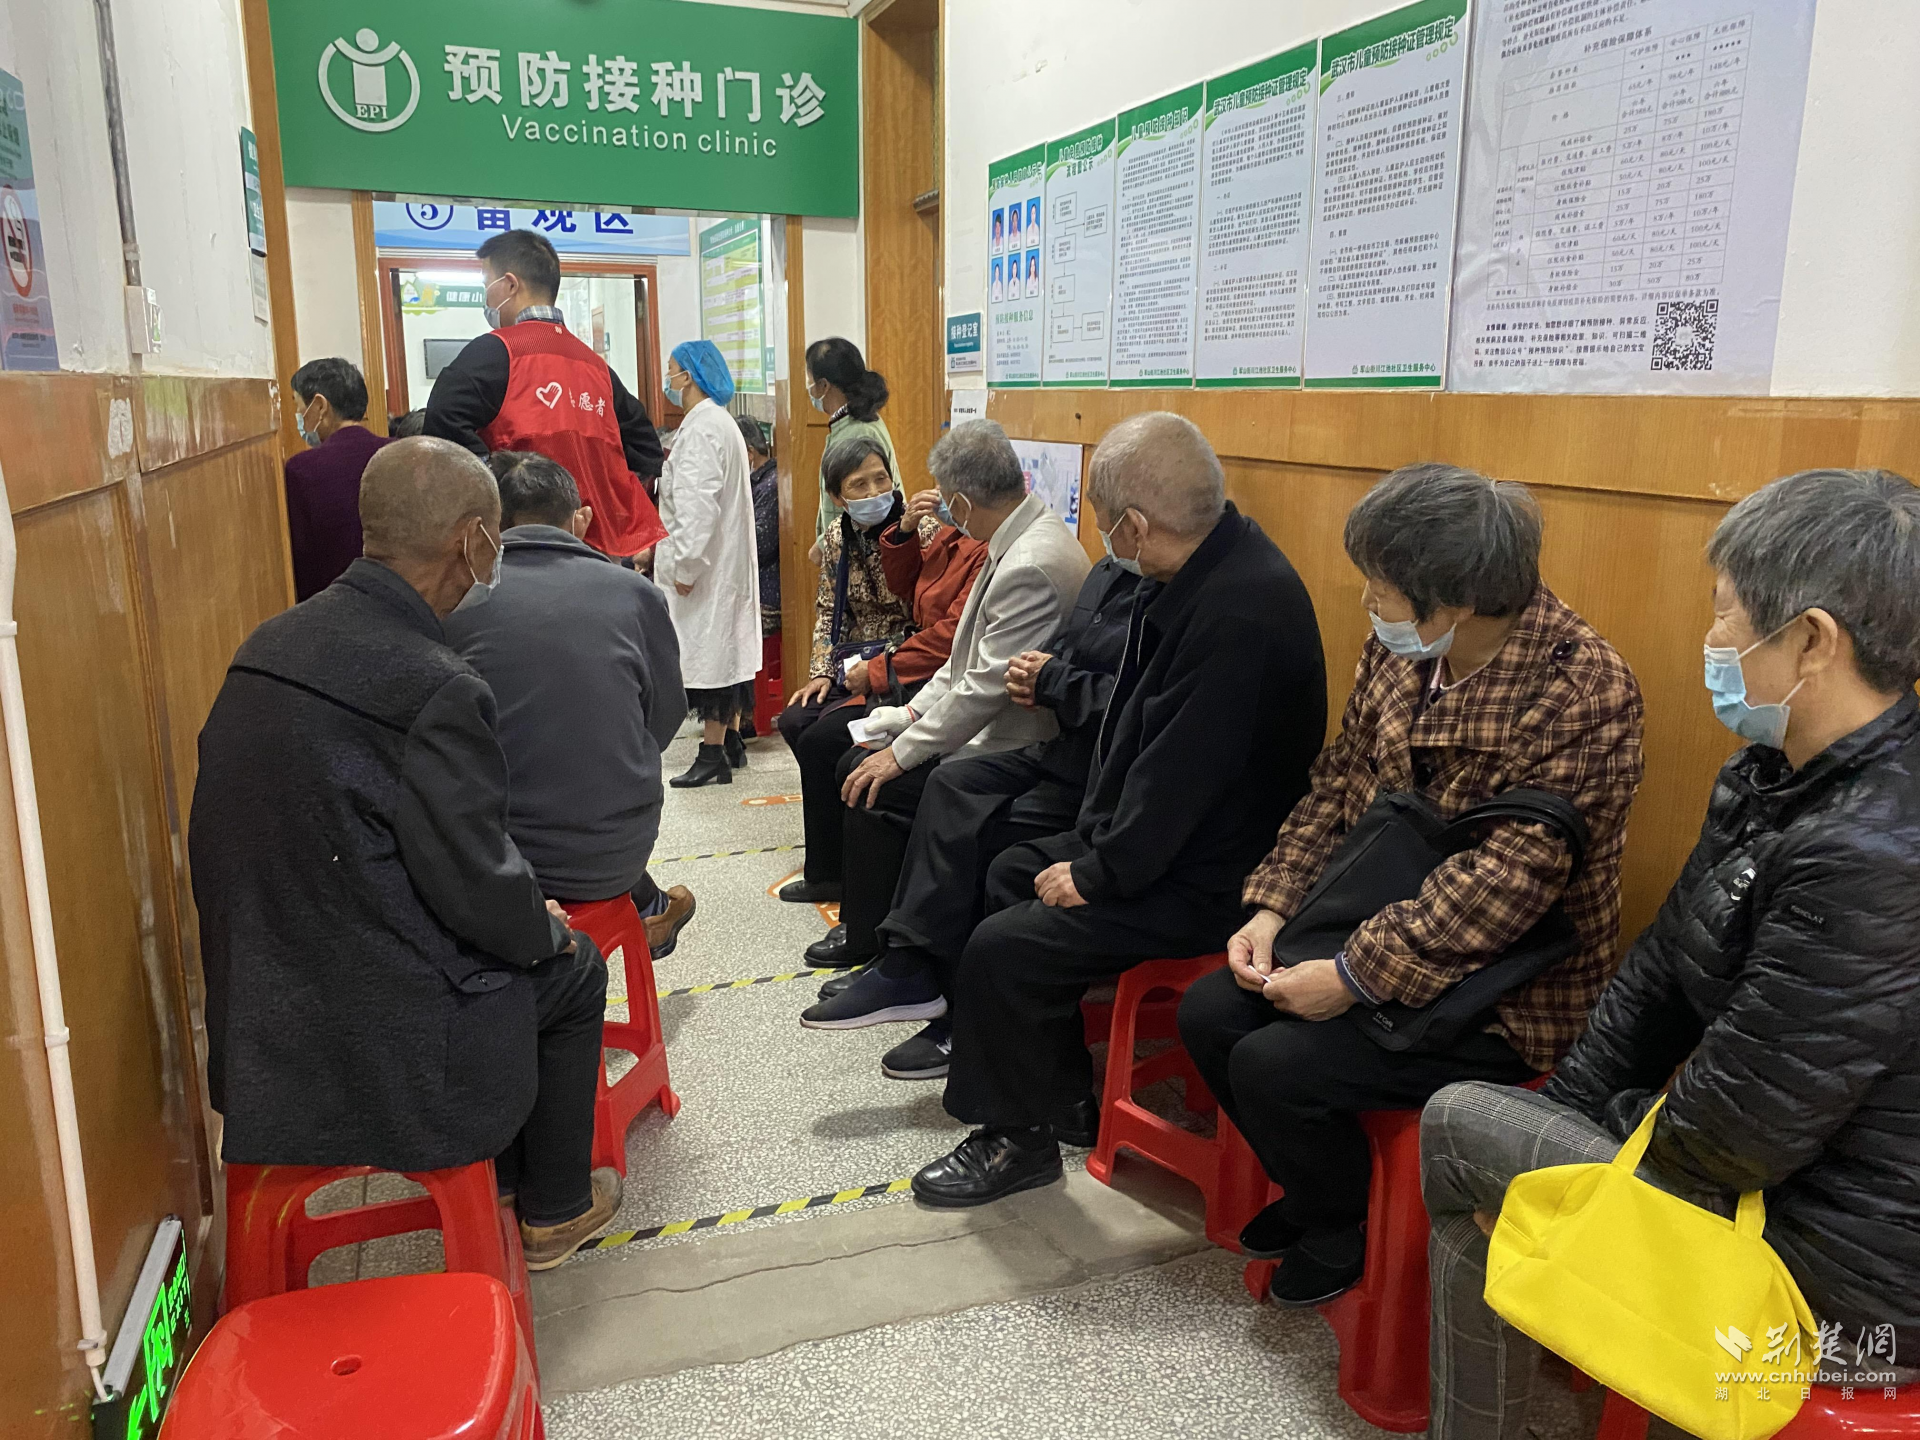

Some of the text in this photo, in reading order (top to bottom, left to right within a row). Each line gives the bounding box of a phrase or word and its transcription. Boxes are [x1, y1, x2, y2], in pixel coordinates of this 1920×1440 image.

[1330, 16, 1454, 78] 武汉市儿童预防接种证管理规定
[1583, 25, 1652, 55] 补充保险保障体系
[444, 44, 826, 128] 预防接种门诊
[1213, 67, 1307, 116] 武汉市儿童预防接种证管理规定
[356, 104, 388, 119] EPI
[502, 114, 778, 157] Vaccination clinic
[951, 322, 978, 340] 接种登记室
[1359, 364, 1435, 373] 军山街川江池社区卫生服务中心
